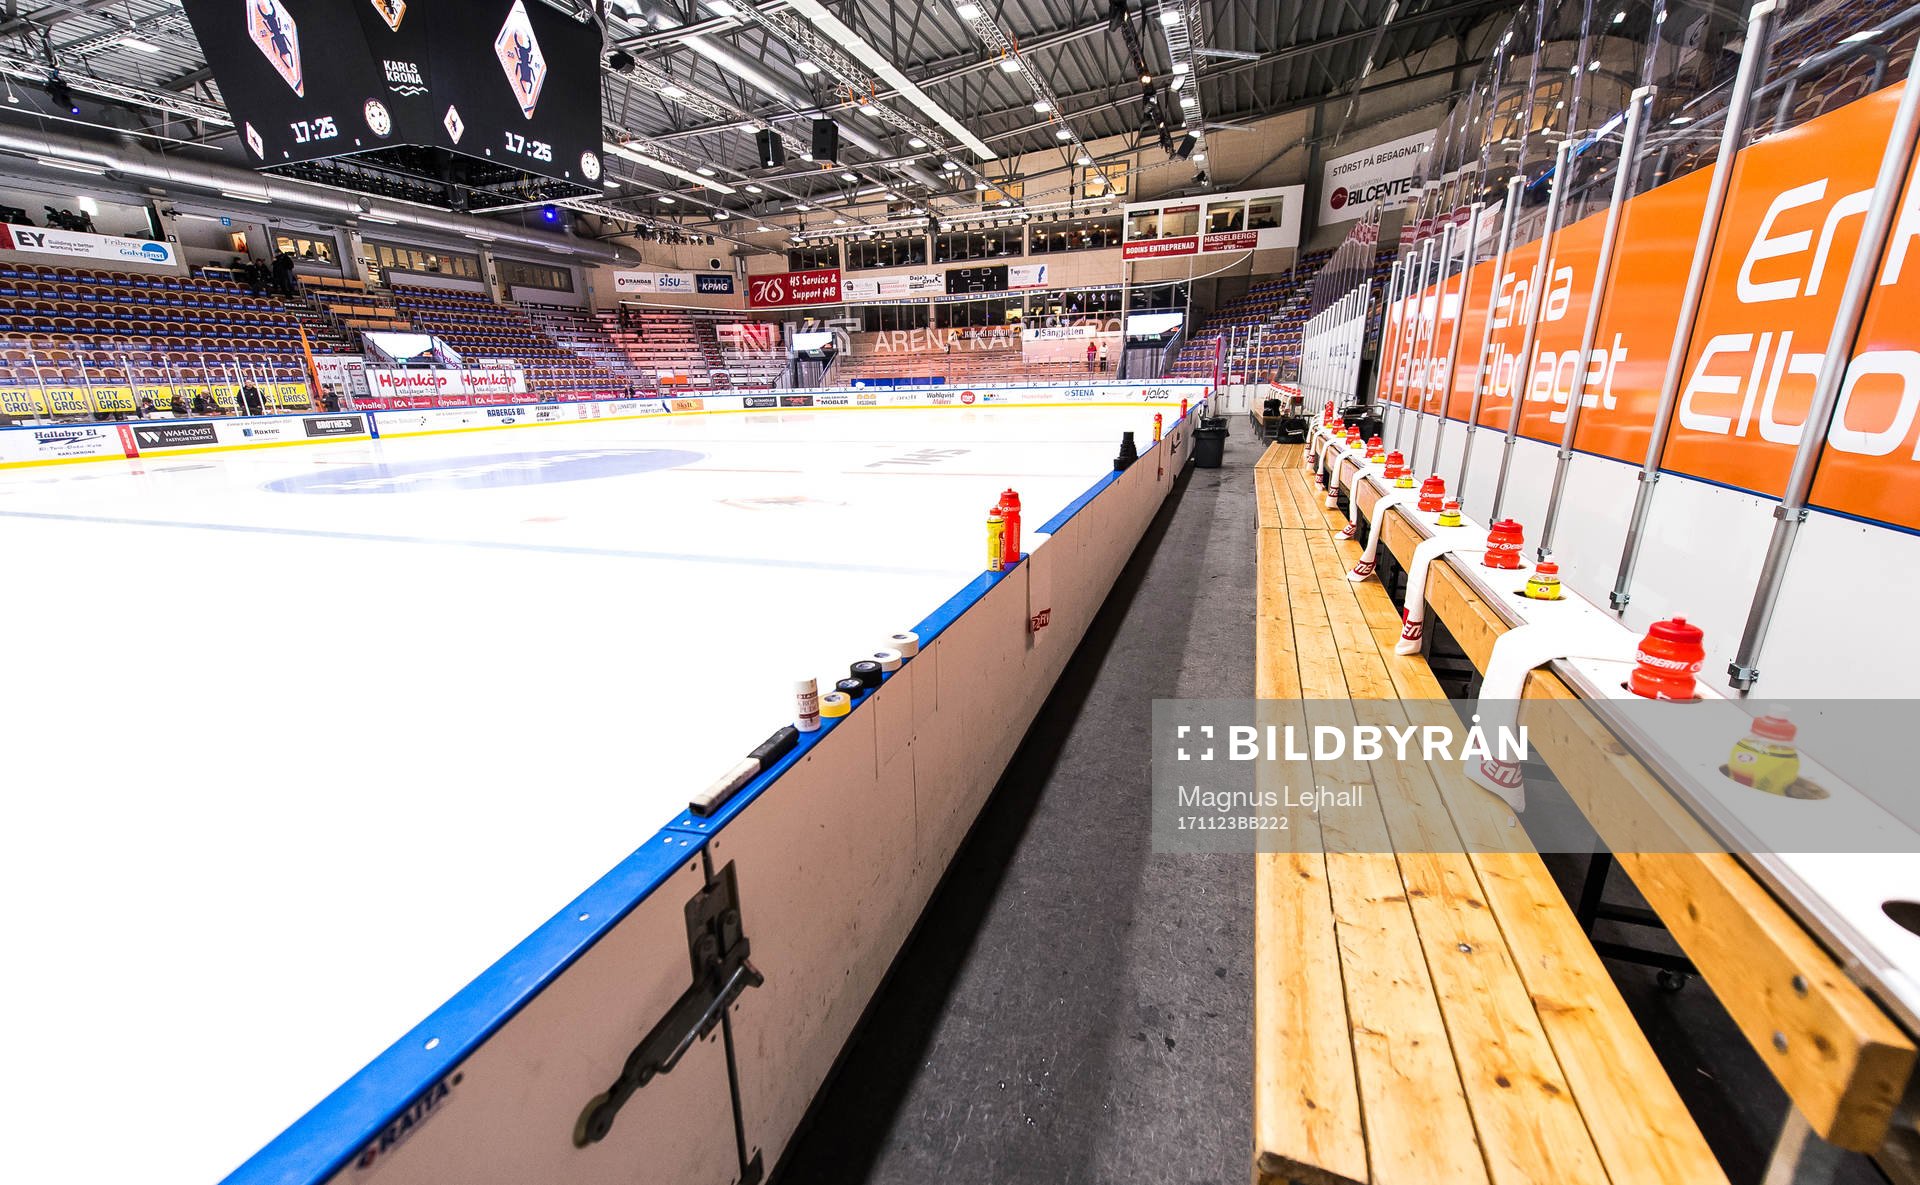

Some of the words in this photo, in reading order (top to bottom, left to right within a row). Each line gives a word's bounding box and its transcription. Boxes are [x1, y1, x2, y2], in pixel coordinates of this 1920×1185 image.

[383, 60, 418, 74] KARLS
[385, 70, 424, 85] KRONA
[290, 116, 339, 145] 17:25
[504, 131, 553, 163] 17:25
[1333, 158, 1363, 177] STÖRST
[1363, 154, 1376, 168] PÅ
[15, 230, 46, 248] EY
[1204, 232, 1257, 243] HASSELBERGS
[1126, 245, 1149, 255] BODINS
[1149, 241, 1195, 253] ENTREPRENAD
[790, 276, 800, 287] HS
[802, 274, 829, 286] Service
[830, 273, 838, 284] &
[702, 283, 728, 291] KPMG
[792, 288, 821, 300] Support
[822, 285, 836, 298] AB
[379, 373, 448, 389] Hemköp
[463, 373, 517, 387] Hemköp
[51, 391, 74, 401] CITY
[96, 390, 119, 400] CITY
[281, 386, 298, 396] CITY
[1070, 389, 1095, 397] STENA
[1, 392, 26, 402] CITY
[283, 394, 307, 403] GROSS
[5, 402, 44, 412] GROSS
[54, 401, 87, 411] GROSS
[100, 400, 133, 410] GROSS
[316, 419, 353, 430] BROTHERS
[34, 428, 83, 439] Hallabro
[86, 428, 97, 436] El
[164, 427, 212, 438] WAHLQVIST
